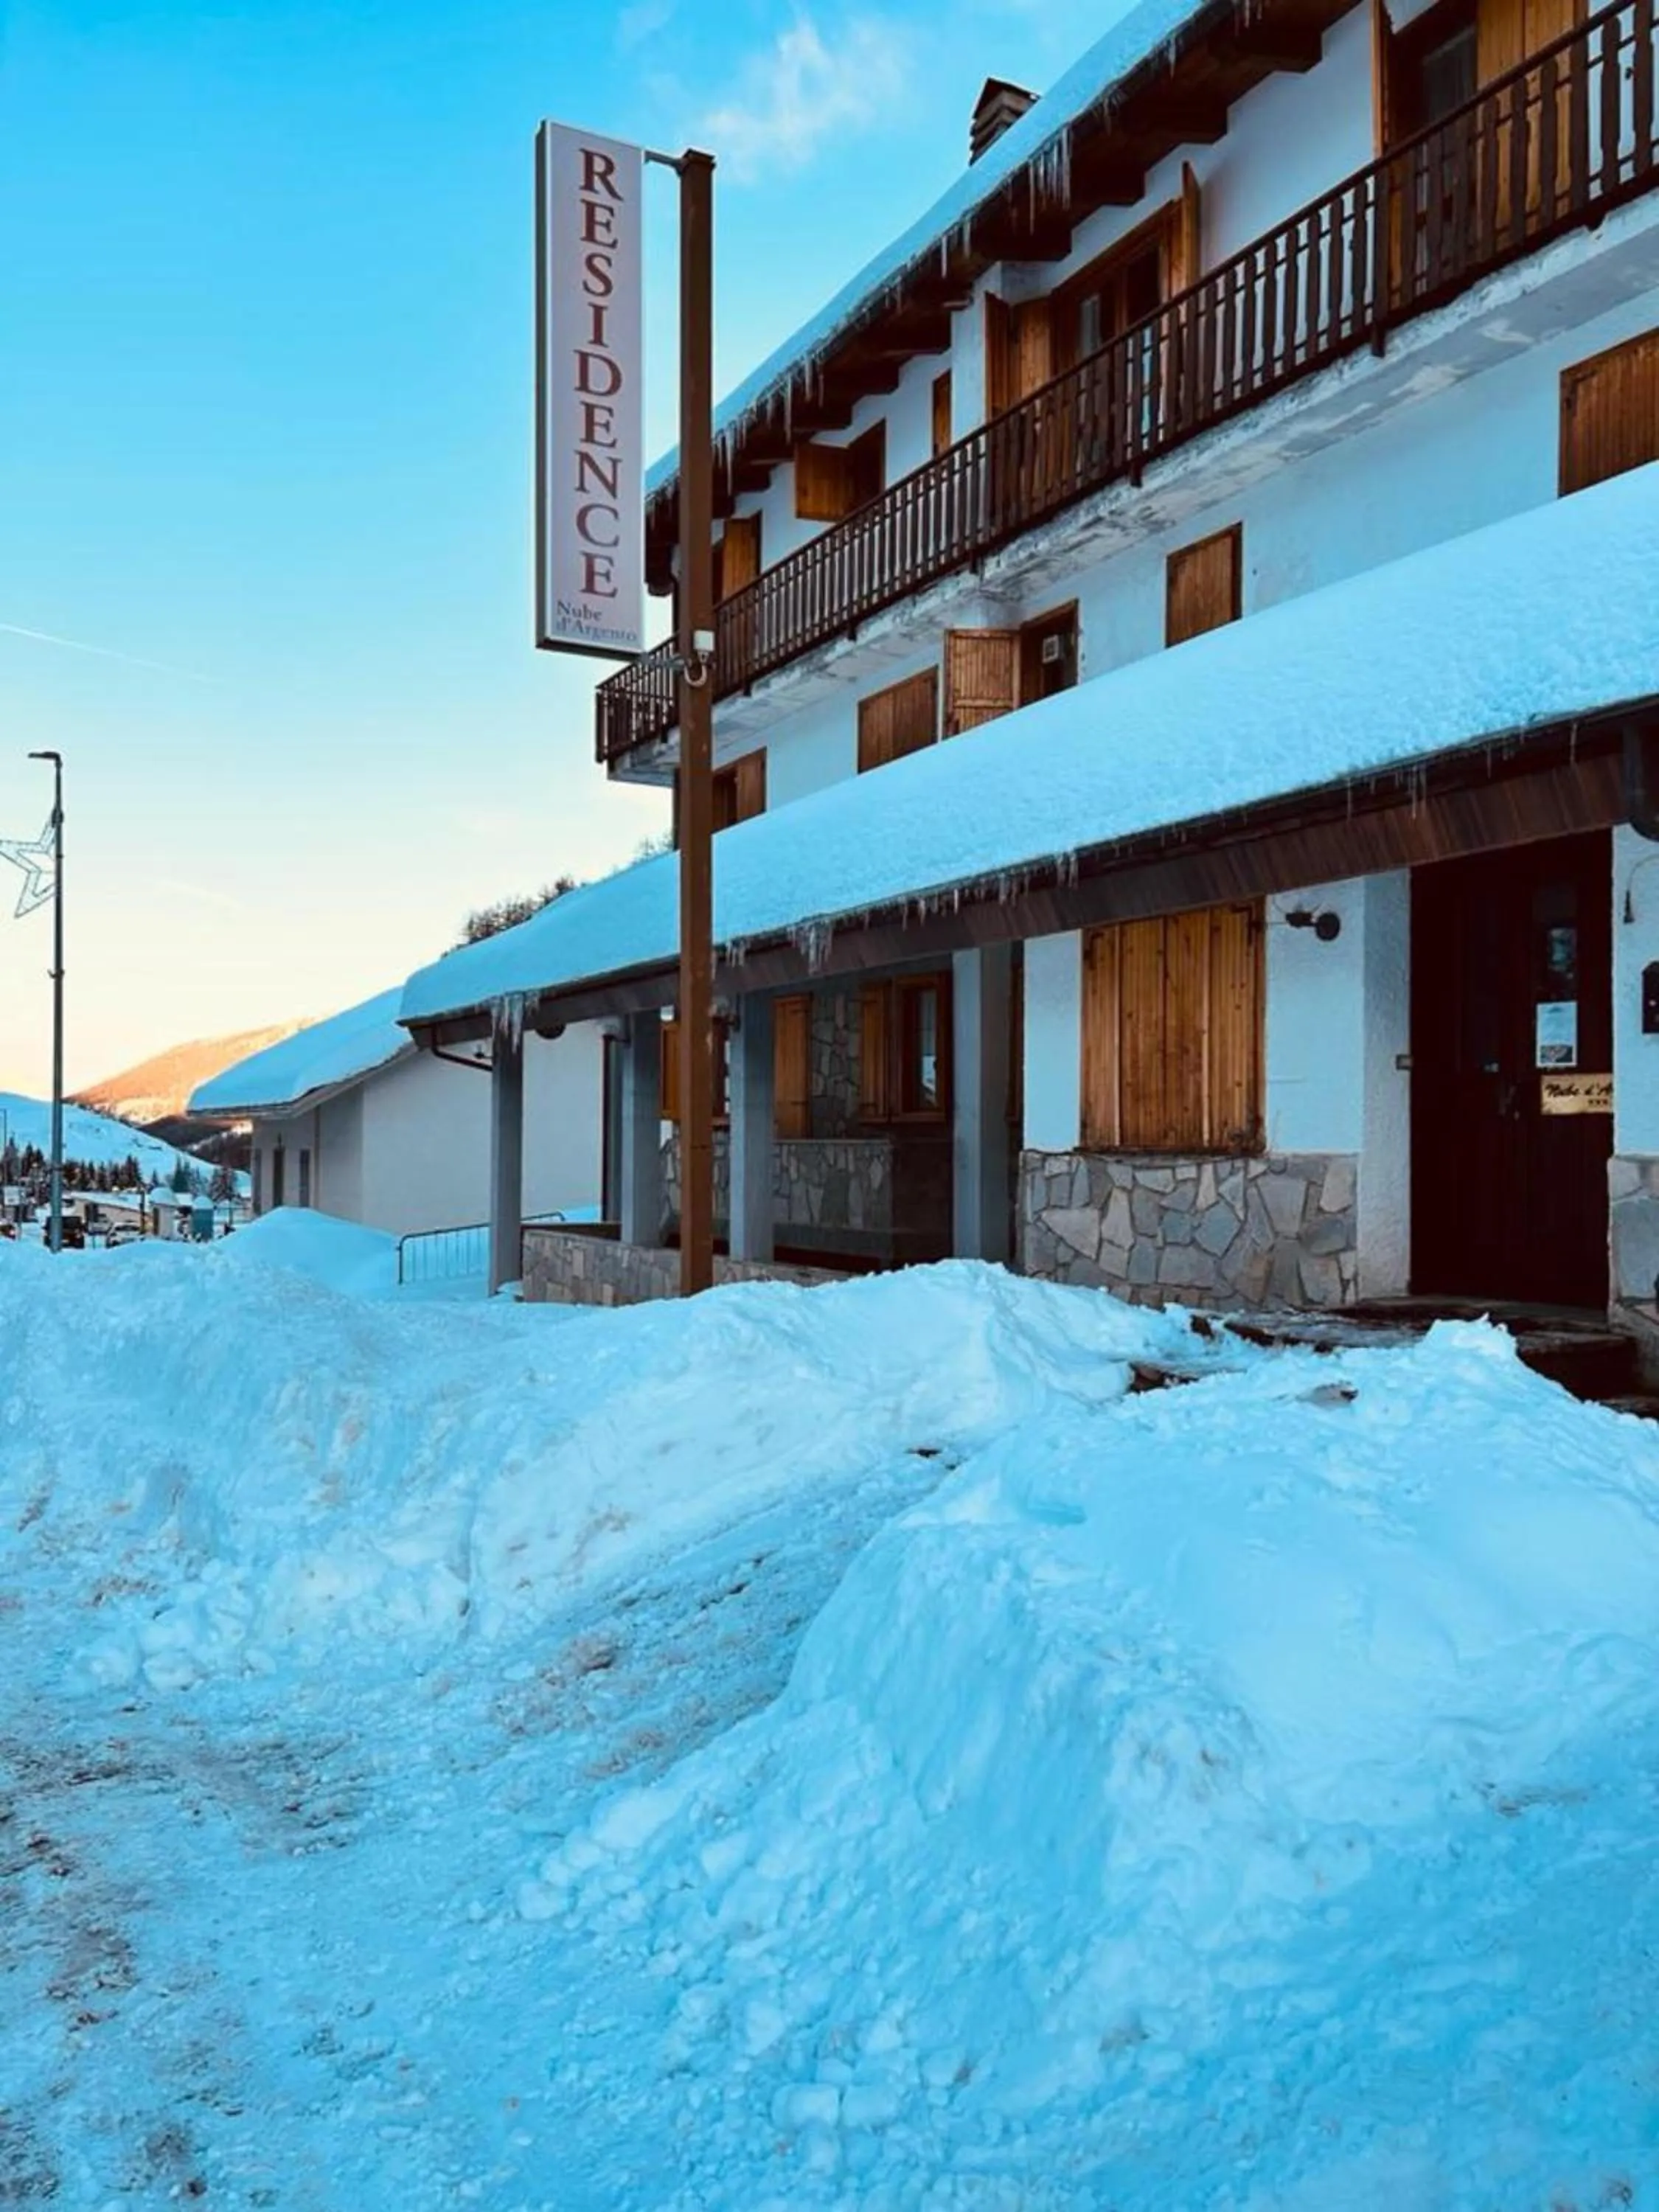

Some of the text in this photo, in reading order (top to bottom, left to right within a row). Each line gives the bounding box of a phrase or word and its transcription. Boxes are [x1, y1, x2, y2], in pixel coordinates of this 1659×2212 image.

[574, 147, 624, 598] RESIDENCE
[556, 599, 603, 622] Nube
[555, 616, 638, 641] d'Argento
